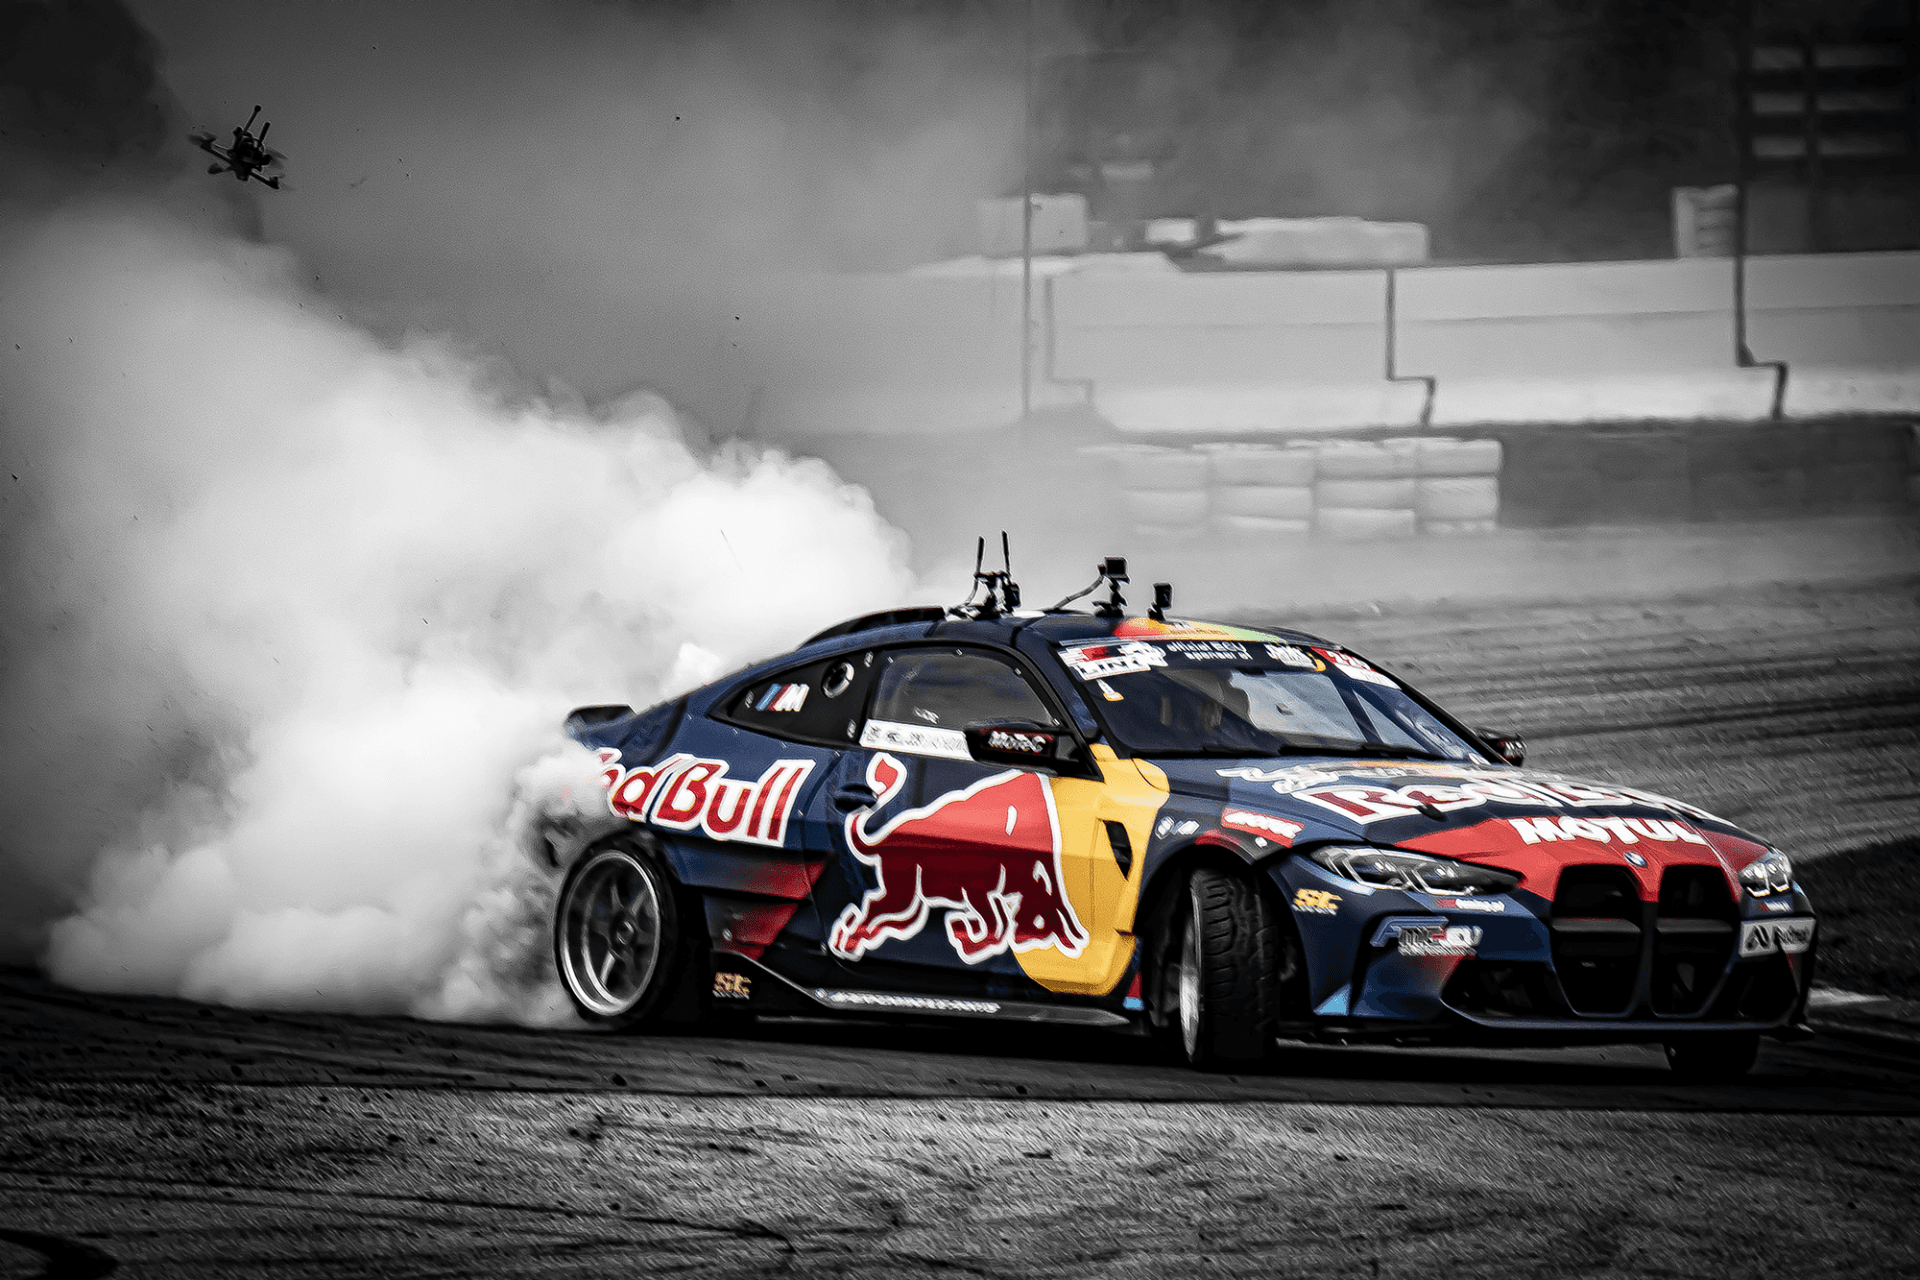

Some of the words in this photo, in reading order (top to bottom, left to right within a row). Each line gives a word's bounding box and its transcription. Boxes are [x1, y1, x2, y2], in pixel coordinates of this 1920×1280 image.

[600, 748, 690, 822] ed
[650, 757, 816, 847] Bull
[1508, 816, 1707, 845] MOTUL
